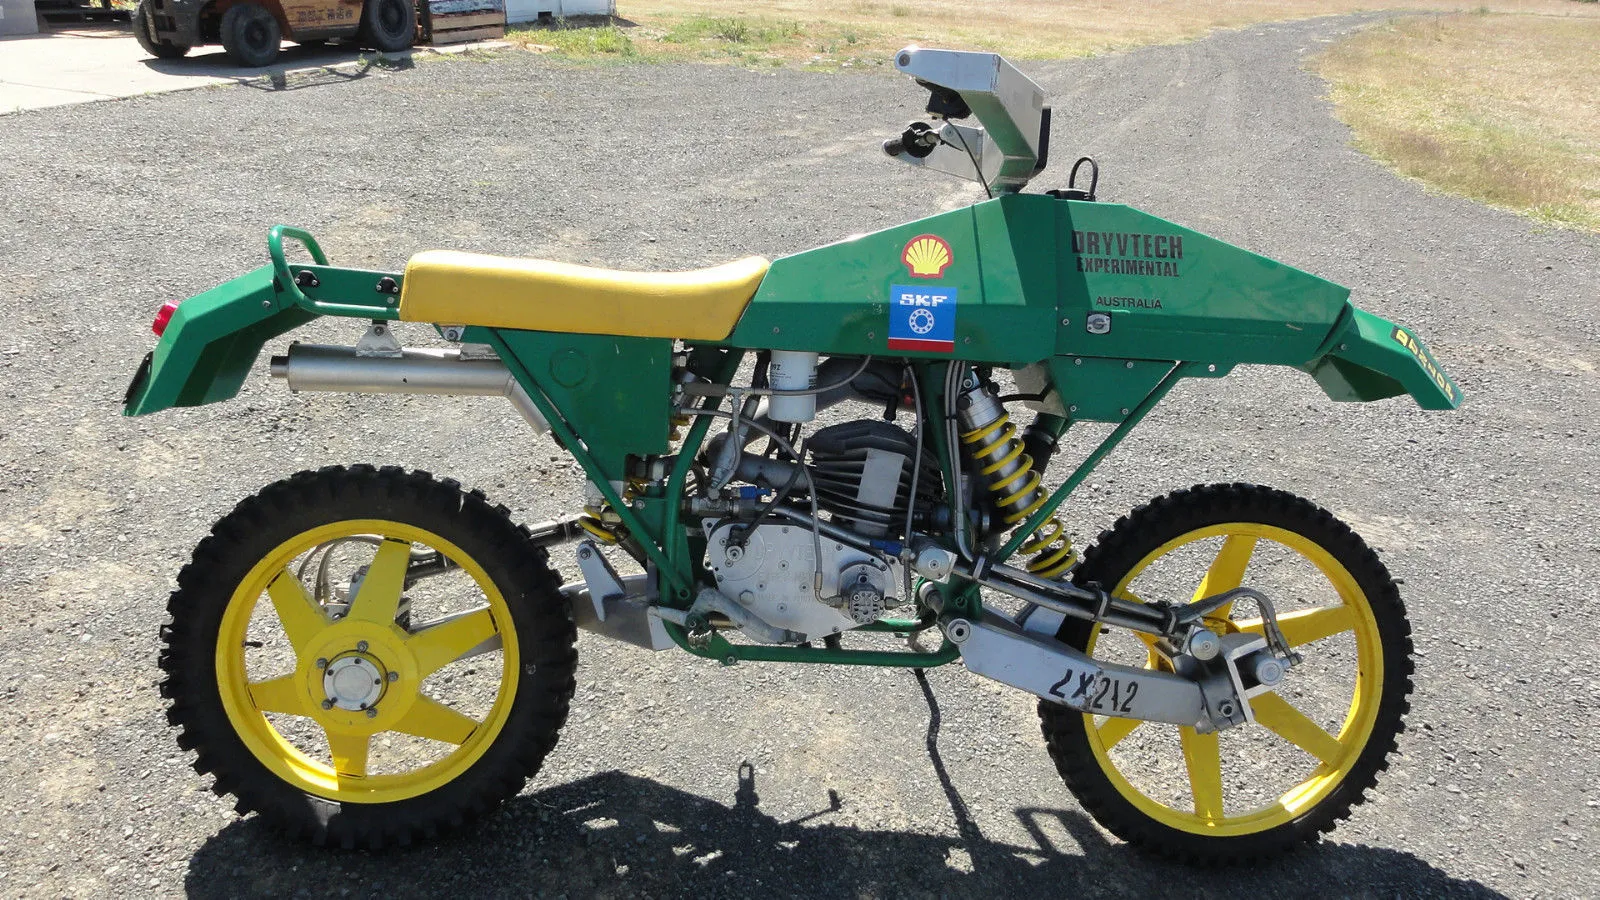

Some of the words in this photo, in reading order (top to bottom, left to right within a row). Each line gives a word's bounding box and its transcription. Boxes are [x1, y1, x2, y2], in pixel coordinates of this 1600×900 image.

[1071, 230, 1183, 260] DRYVTECH
[1077, 257, 1180, 277] EXPERIMENTAL
[899, 293, 948, 307] SKF
[1096, 296, 1163, 310] AUSTRALIA
